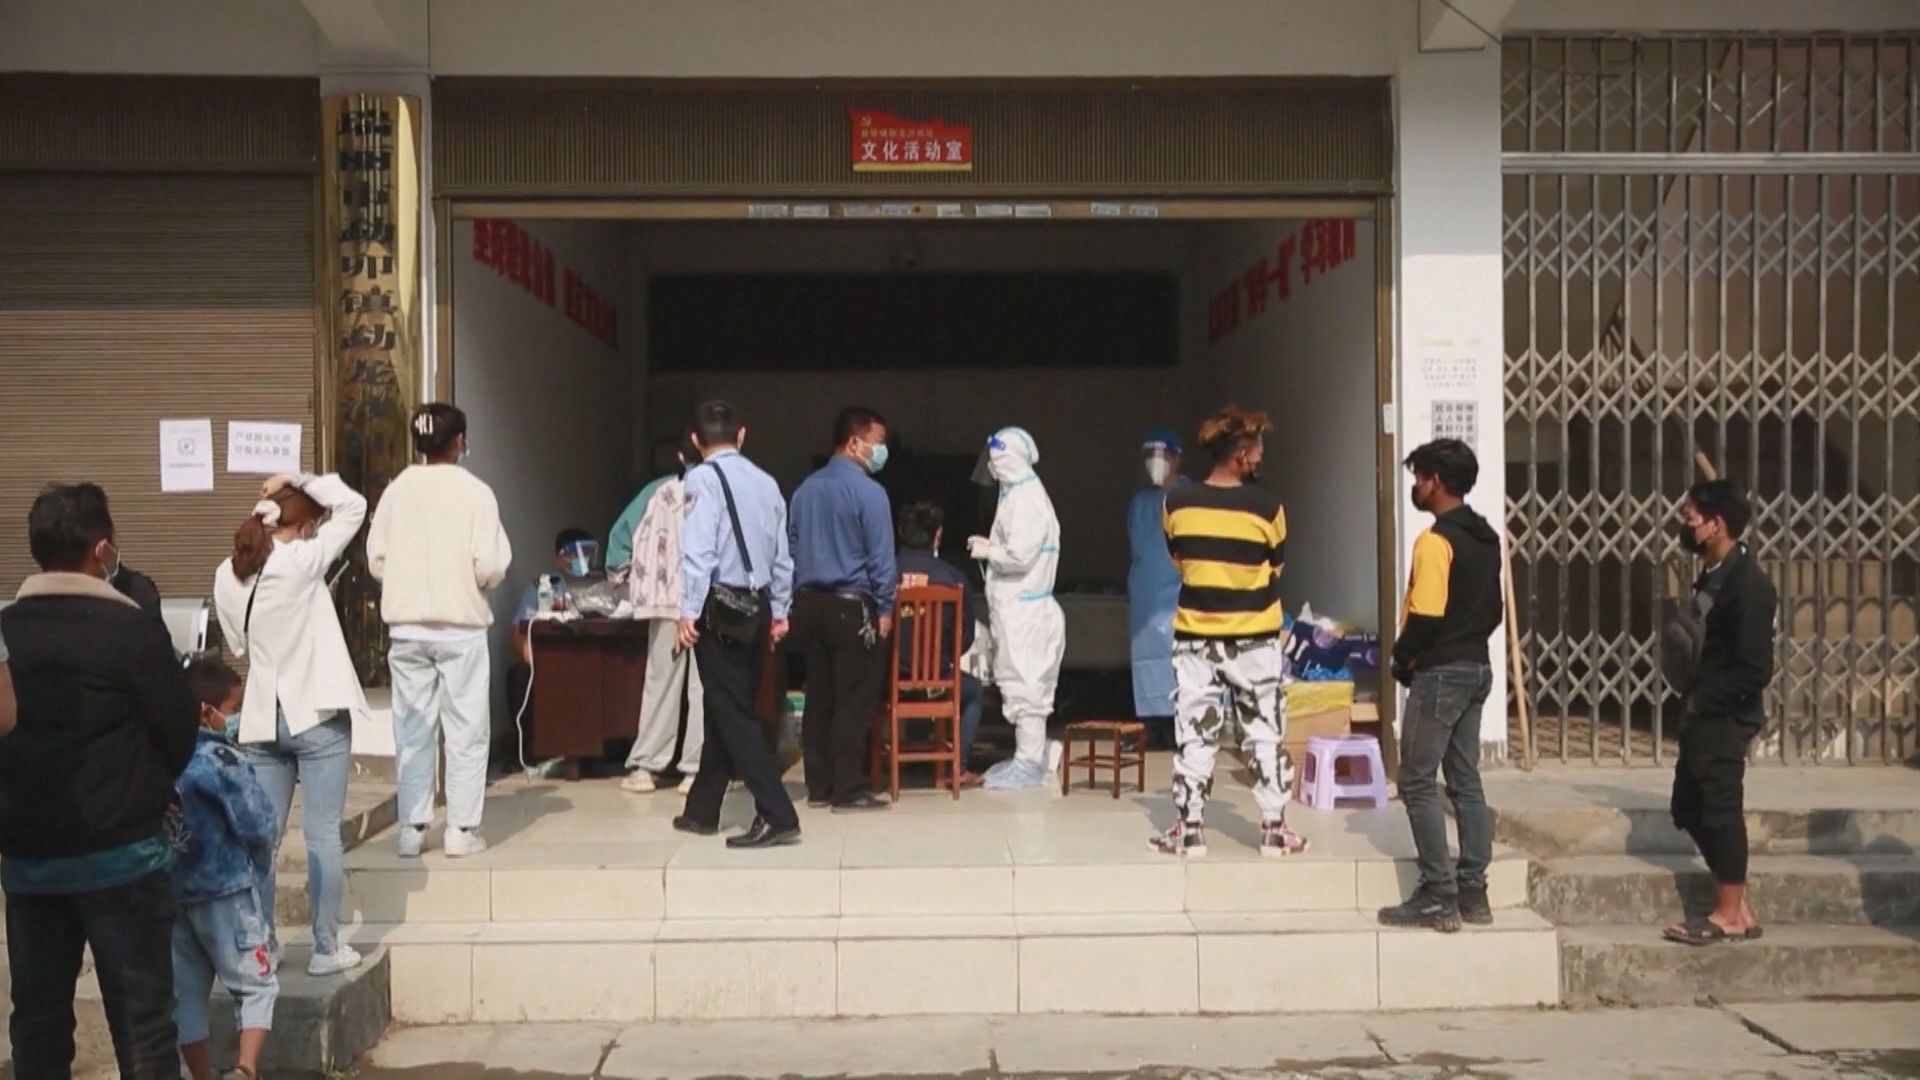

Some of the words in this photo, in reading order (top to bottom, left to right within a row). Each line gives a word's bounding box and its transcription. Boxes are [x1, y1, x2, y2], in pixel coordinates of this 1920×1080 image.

[861, 140, 962, 161] 文化活动室
